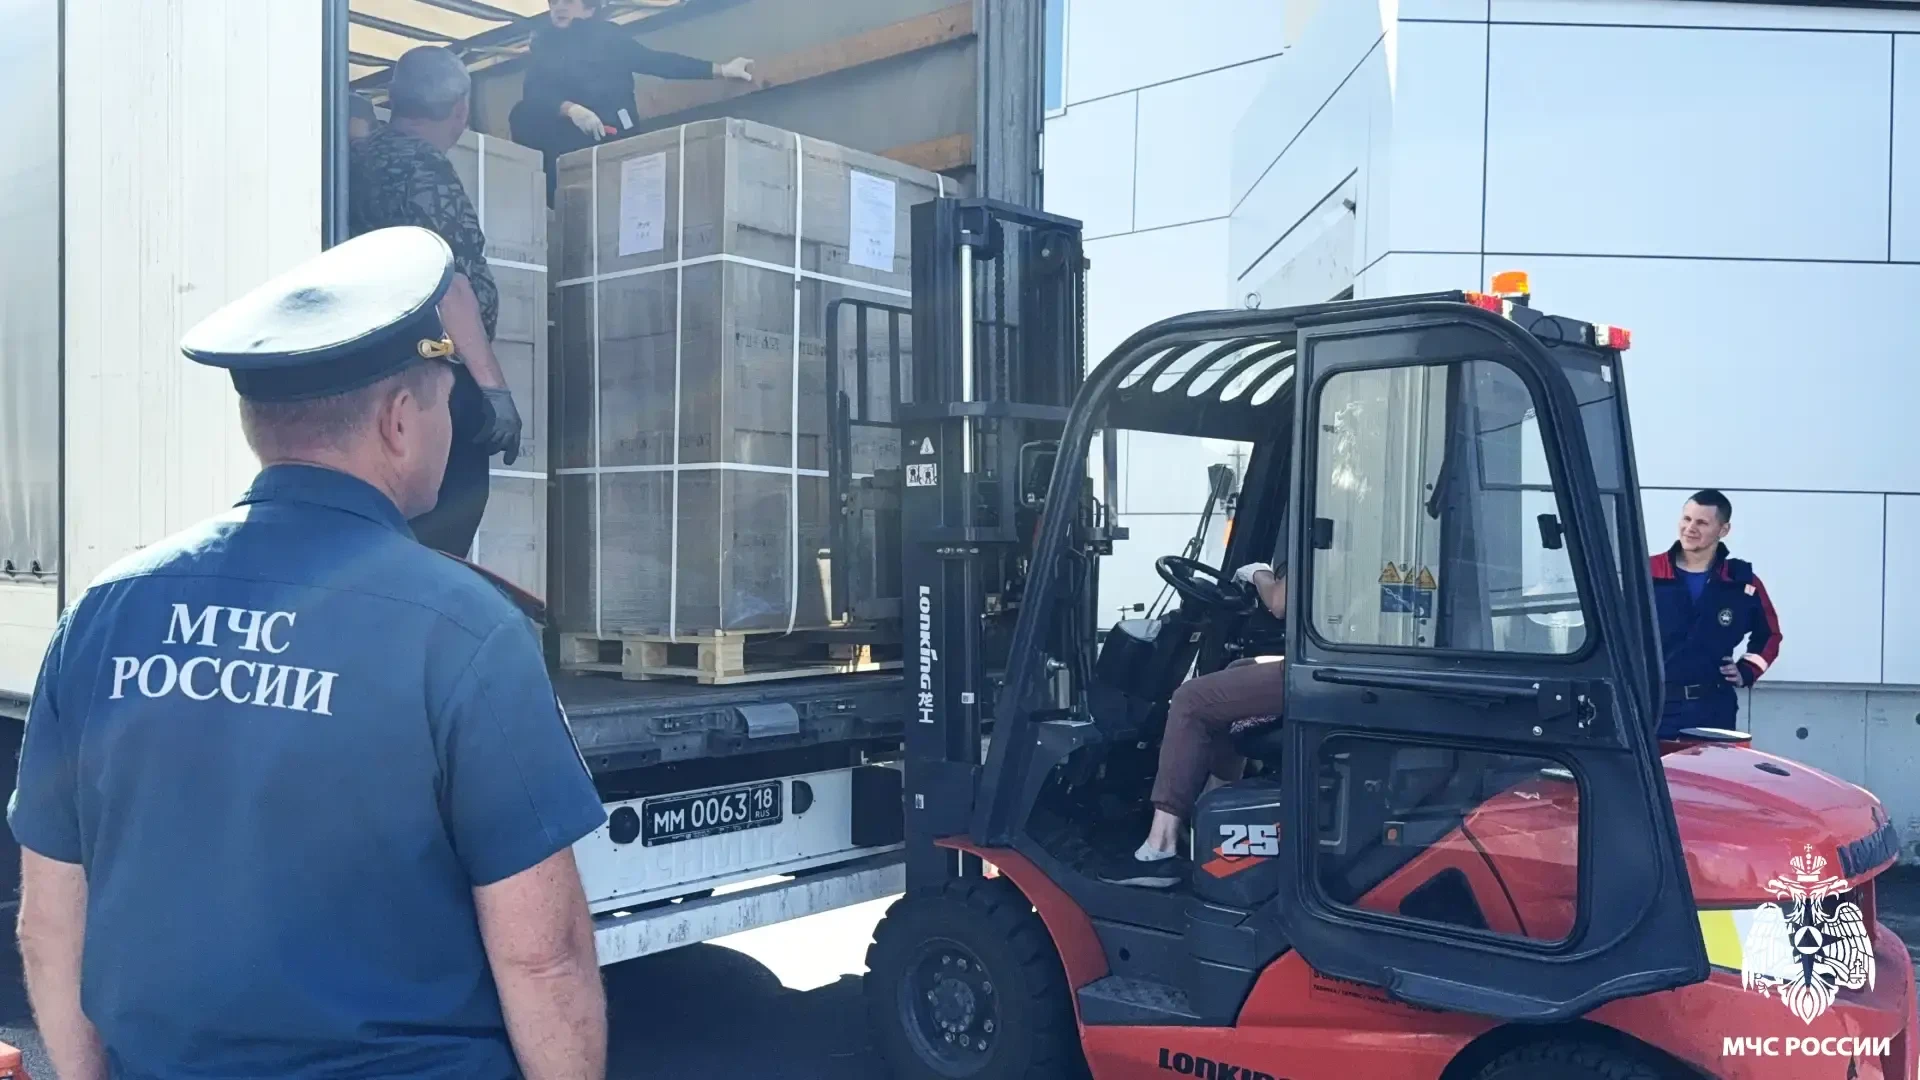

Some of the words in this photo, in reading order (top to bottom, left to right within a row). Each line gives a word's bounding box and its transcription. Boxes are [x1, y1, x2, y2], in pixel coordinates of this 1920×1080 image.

[162, 603, 297, 654] МЧС
[109, 654, 339, 716] РОССИИ
[691, 792, 747, 828] 0063
[754, 788, 773, 809] 18
[755, 809, 770, 818] RUS
[1219, 824, 1279, 856] 25
[1158, 1048, 1293, 1080] LONKI
